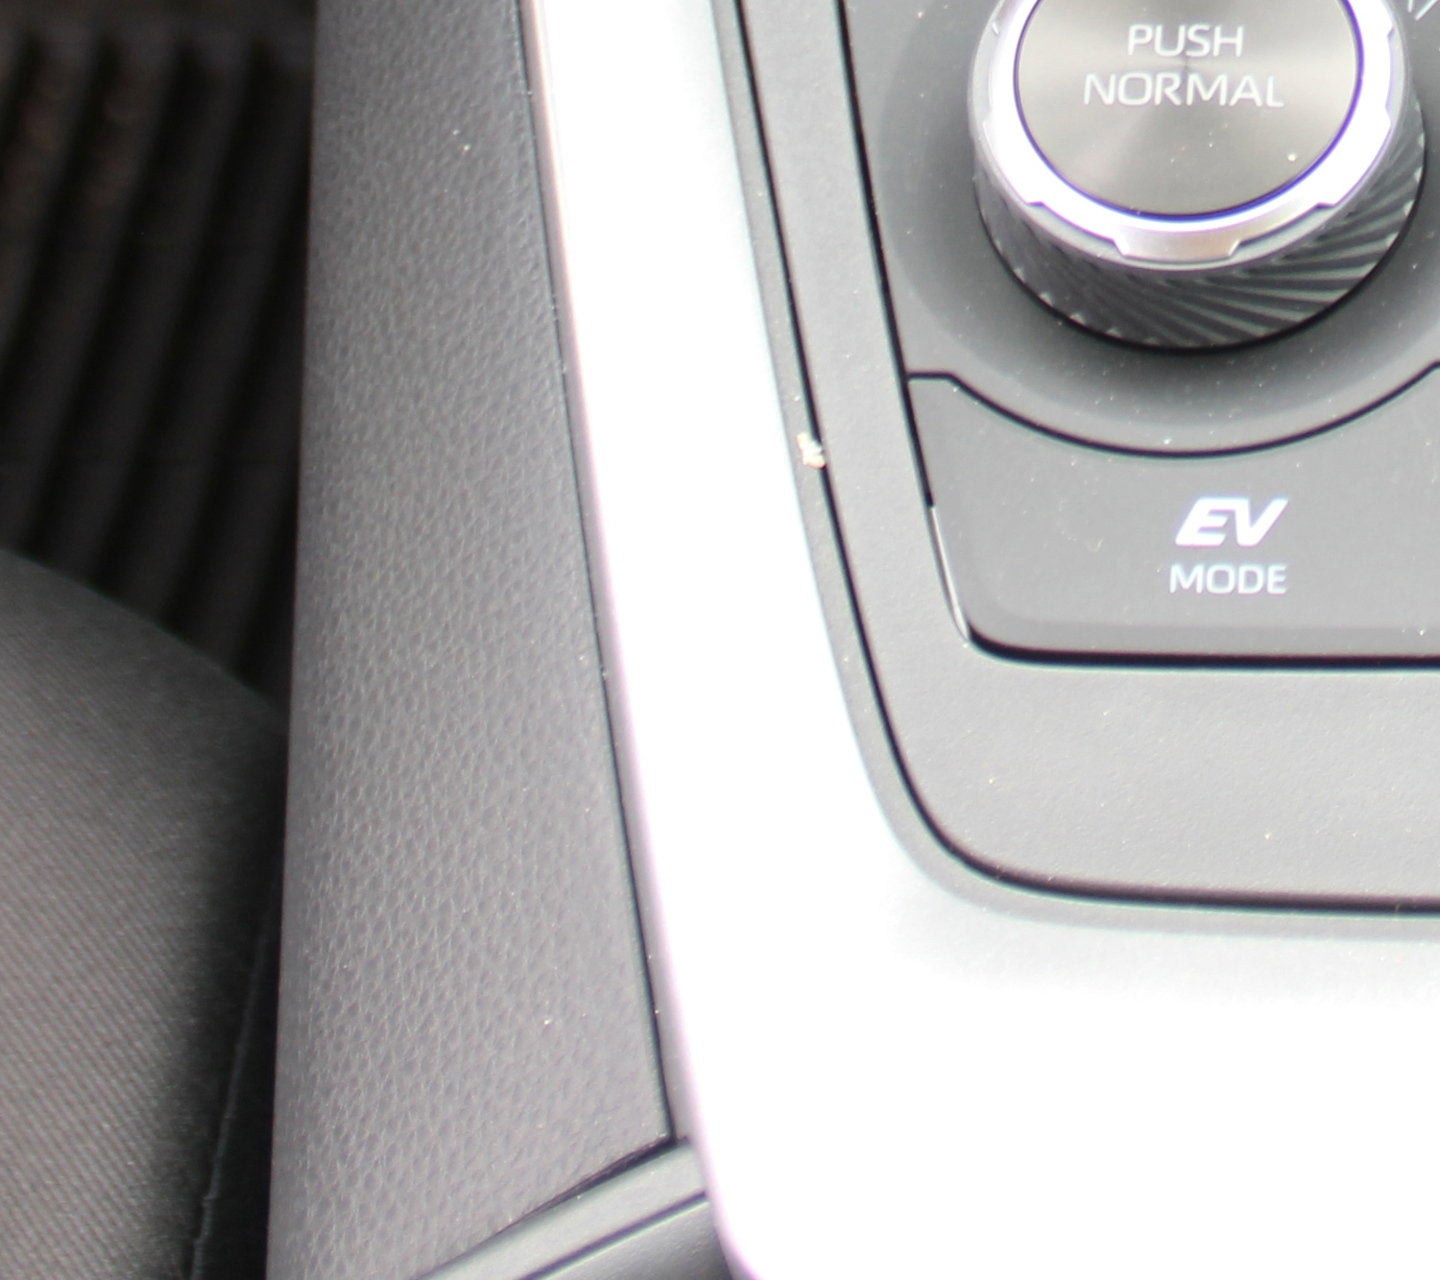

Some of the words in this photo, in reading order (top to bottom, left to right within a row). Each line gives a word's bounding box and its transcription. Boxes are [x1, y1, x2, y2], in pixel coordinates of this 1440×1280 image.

[1127, 24, 1244, 58] PUSH
[1083, 72, 1285, 108] NORMAL
[1174, 497, 1289, 546] EV
[1169, 564, 1288, 595] MODE
